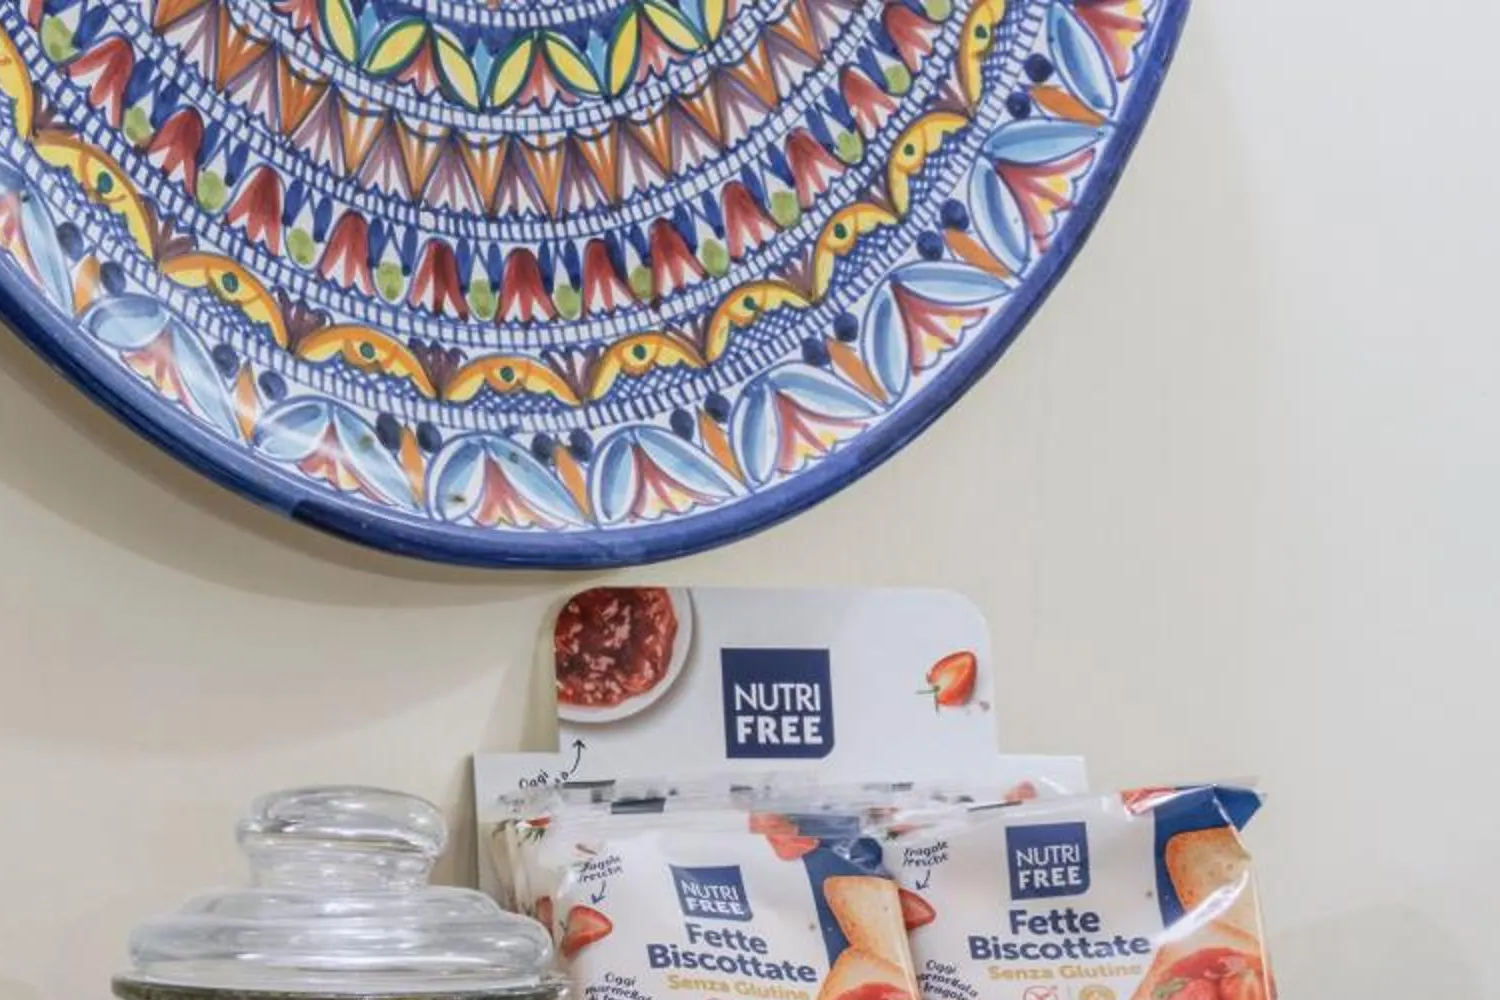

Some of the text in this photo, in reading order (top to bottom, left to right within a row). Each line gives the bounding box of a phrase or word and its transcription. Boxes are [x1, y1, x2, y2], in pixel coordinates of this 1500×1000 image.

[734, 682, 821, 712] NUTRI
[736, 715, 824, 745] FREE
[1015, 844, 1081, 867] NUTRI
[680, 878, 740, 900] NUTRI
[1018, 866, 1083, 890] FREE
[686, 898, 746, 917] FREE
[1008, 907, 1101, 935] Fette
[685, 922, 769, 956] Fette
[967, 934, 1152, 961] Biscottate
[646, 943, 818, 983] Biscottate
[986, 962, 1142, 981] Senza Glutine
[666, 973, 731, 993] Senza
